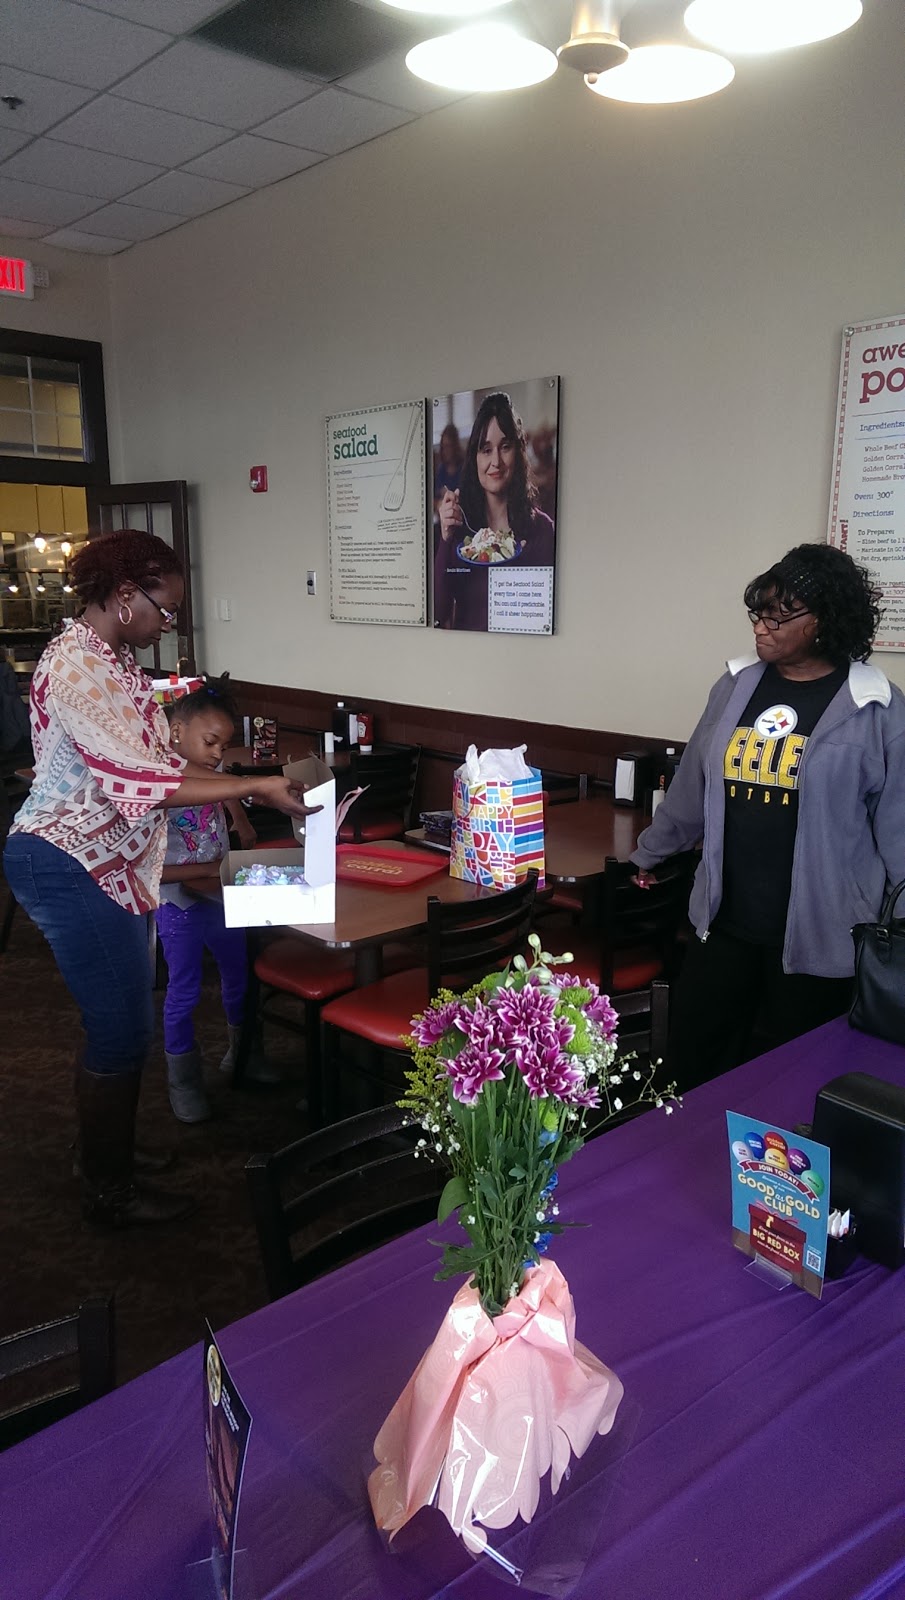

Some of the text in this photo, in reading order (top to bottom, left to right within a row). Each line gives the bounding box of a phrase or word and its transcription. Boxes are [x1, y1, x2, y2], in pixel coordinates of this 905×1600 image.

[333, 423, 367, 440] seafood
[333, 434, 379, 460] salad
[853, 510, 895, 518] Directions:
[471, 820, 515, 833] BIRTH
[473, 832, 515, 852] DAY
[758, 1164, 773, 1173] JOIN
[774, 1168, 799, 1186] TODAY!
[738, 1173, 820, 1219] GOOD as GOLD
[764, 1195, 793, 1217] CLUB
[752, 1228, 766, 1241] BIG
[767, 1236, 782, 1249] RED
[783, 1245, 800, 1261] BOX
